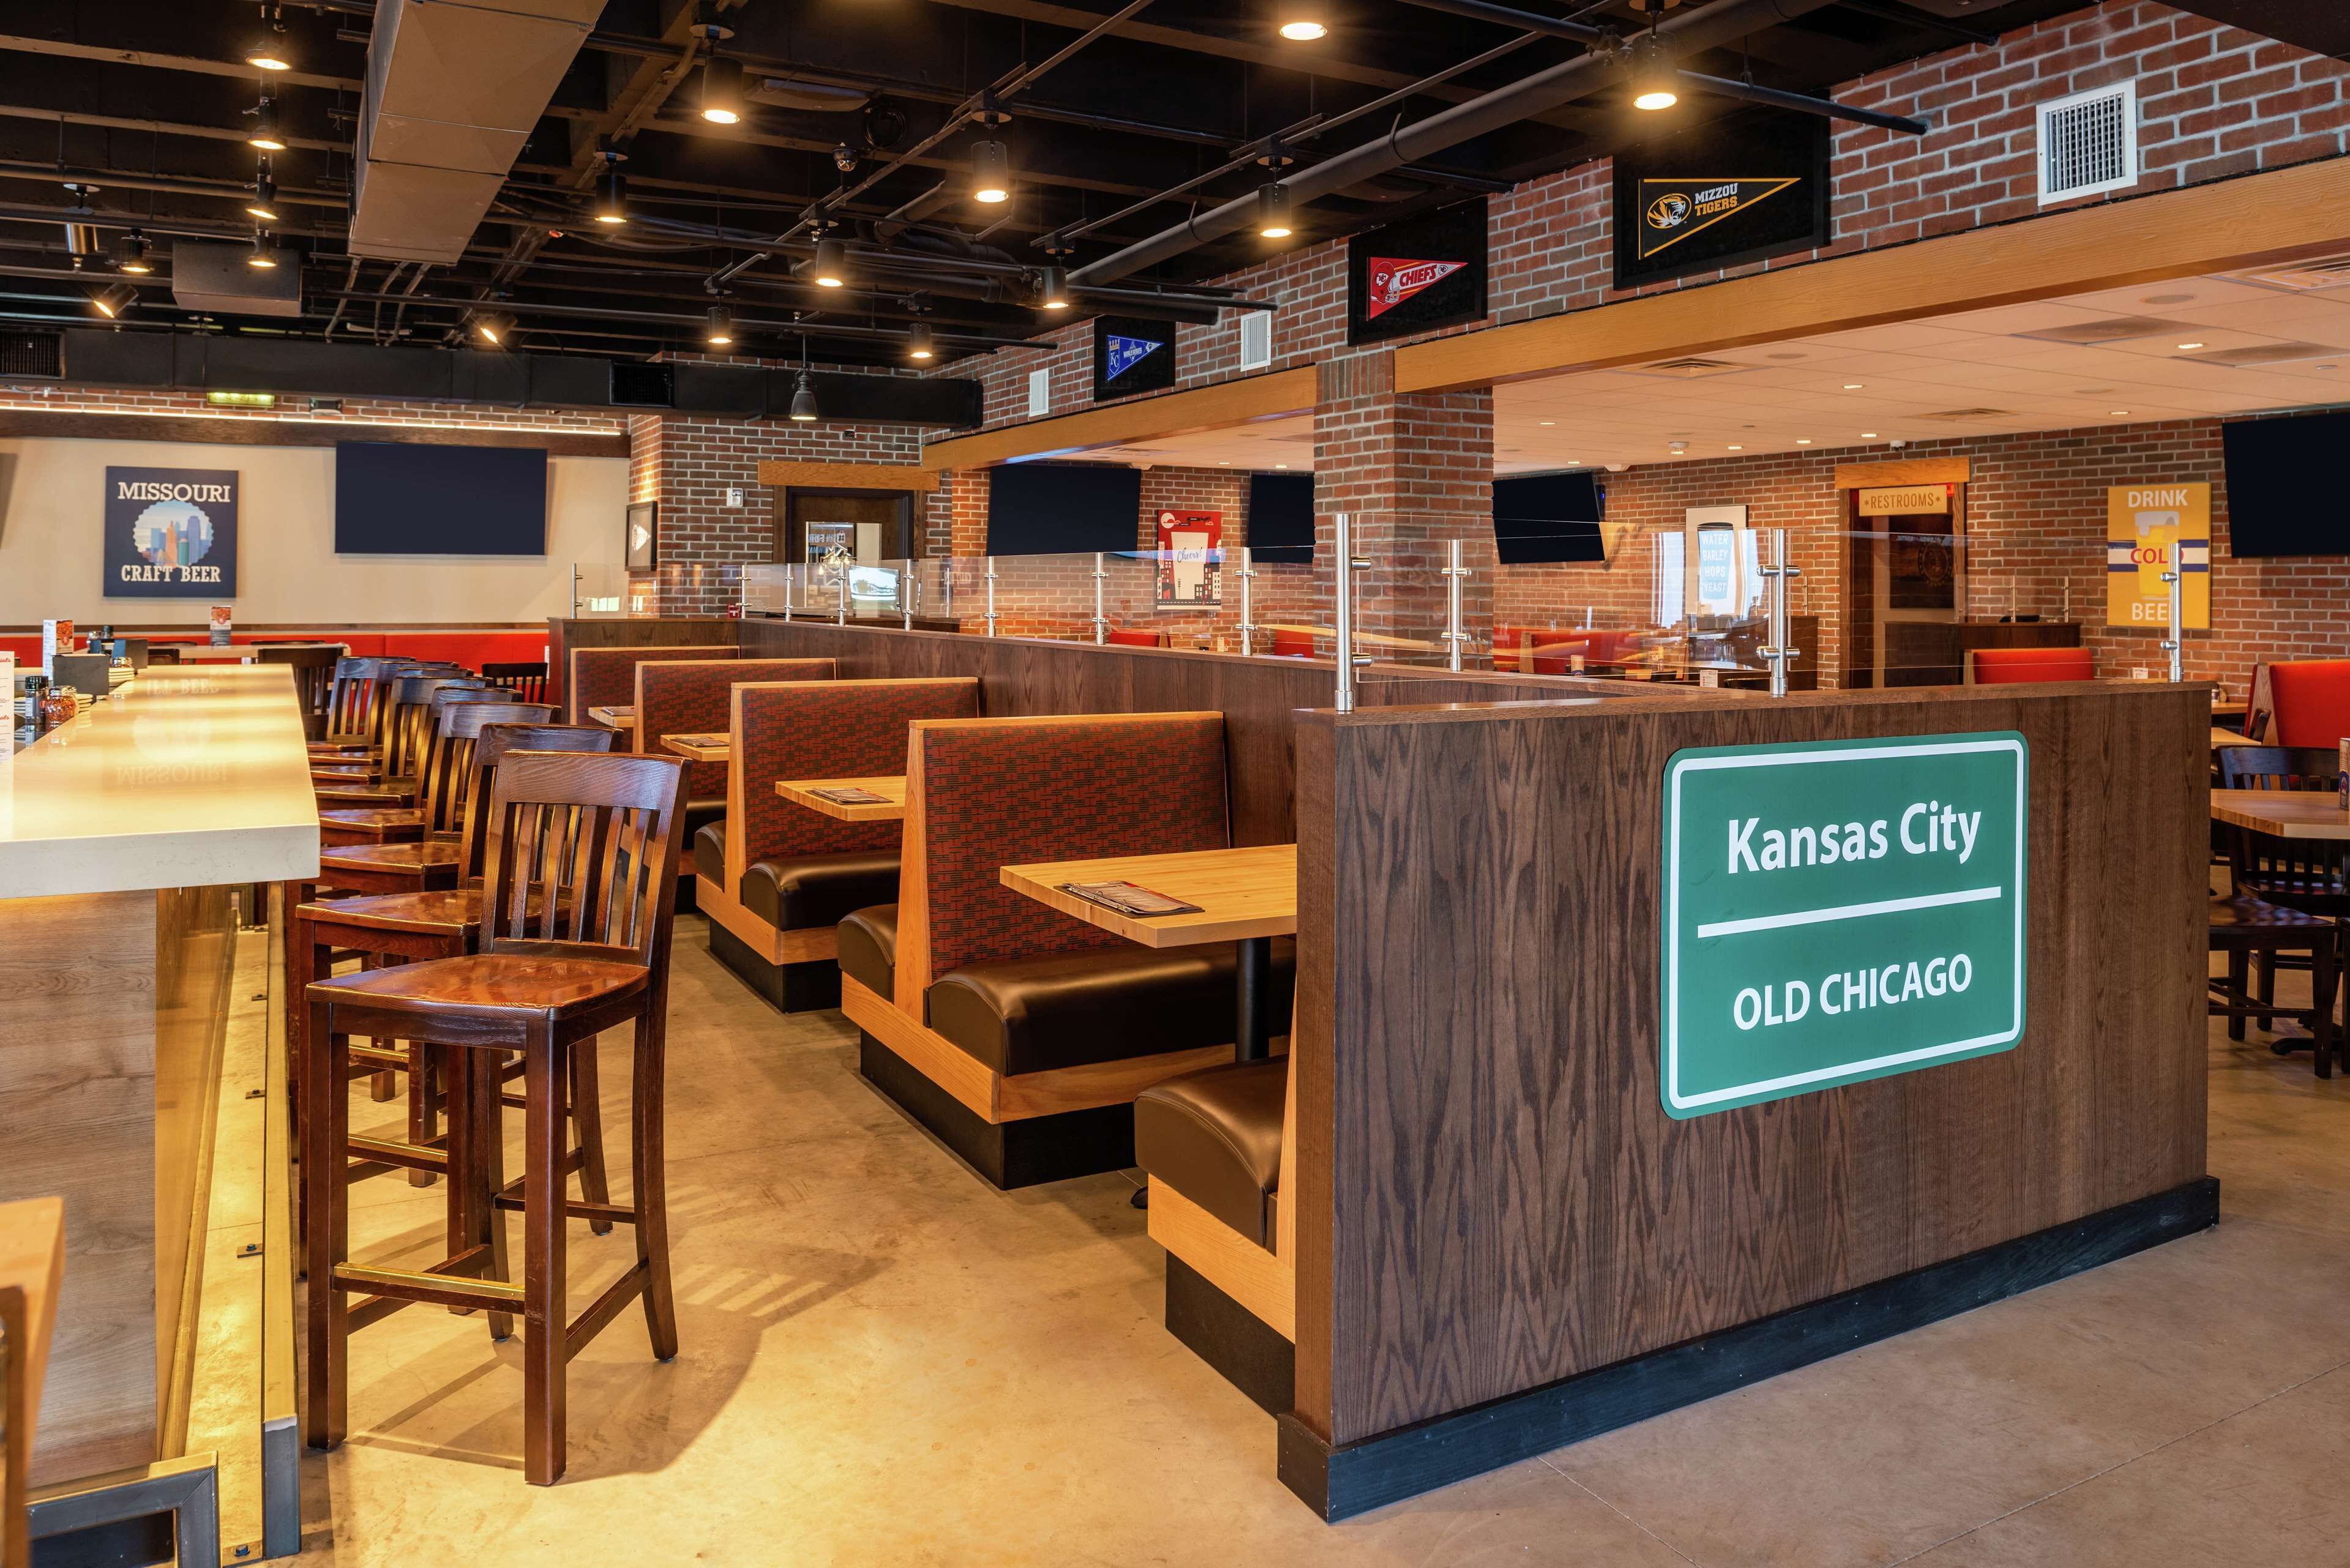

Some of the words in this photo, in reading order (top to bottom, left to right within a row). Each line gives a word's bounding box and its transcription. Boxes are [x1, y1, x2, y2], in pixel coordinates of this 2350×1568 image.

[1694, 183, 1738, 204] MIZZOU
[1694, 196, 1738, 216] TIGERS
[1399, 264, 1437, 286] CHIEFS
[1110, 352, 1119, 367] KC
[118, 482, 231, 502] MISSOURI
[1871, 493, 1934, 509] RESTROOMS
[2128, 489, 2188, 507] DRINK
[1702, 532, 1728, 545] WATER
[1177, 547, 1203, 562] Cheers!
[1703, 549, 1728, 561] BARLEY
[2130, 548, 2184, 564] COL
[121, 564, 173, 581] CRAFT
[180, 566, 221, 582] BEER
[1705, 565, 1726, 578] HOPS
[1704, 582, 1727, 593] YEAST
[2131, 602, 2171, 621] BEE
[1728, 817, 1888, 874] Kansas
[1900, 800, 1981, 864] City
[1734, 980, 1810, 1030] OLD
[1820, 954, 1972, 1015] CHICAGO
